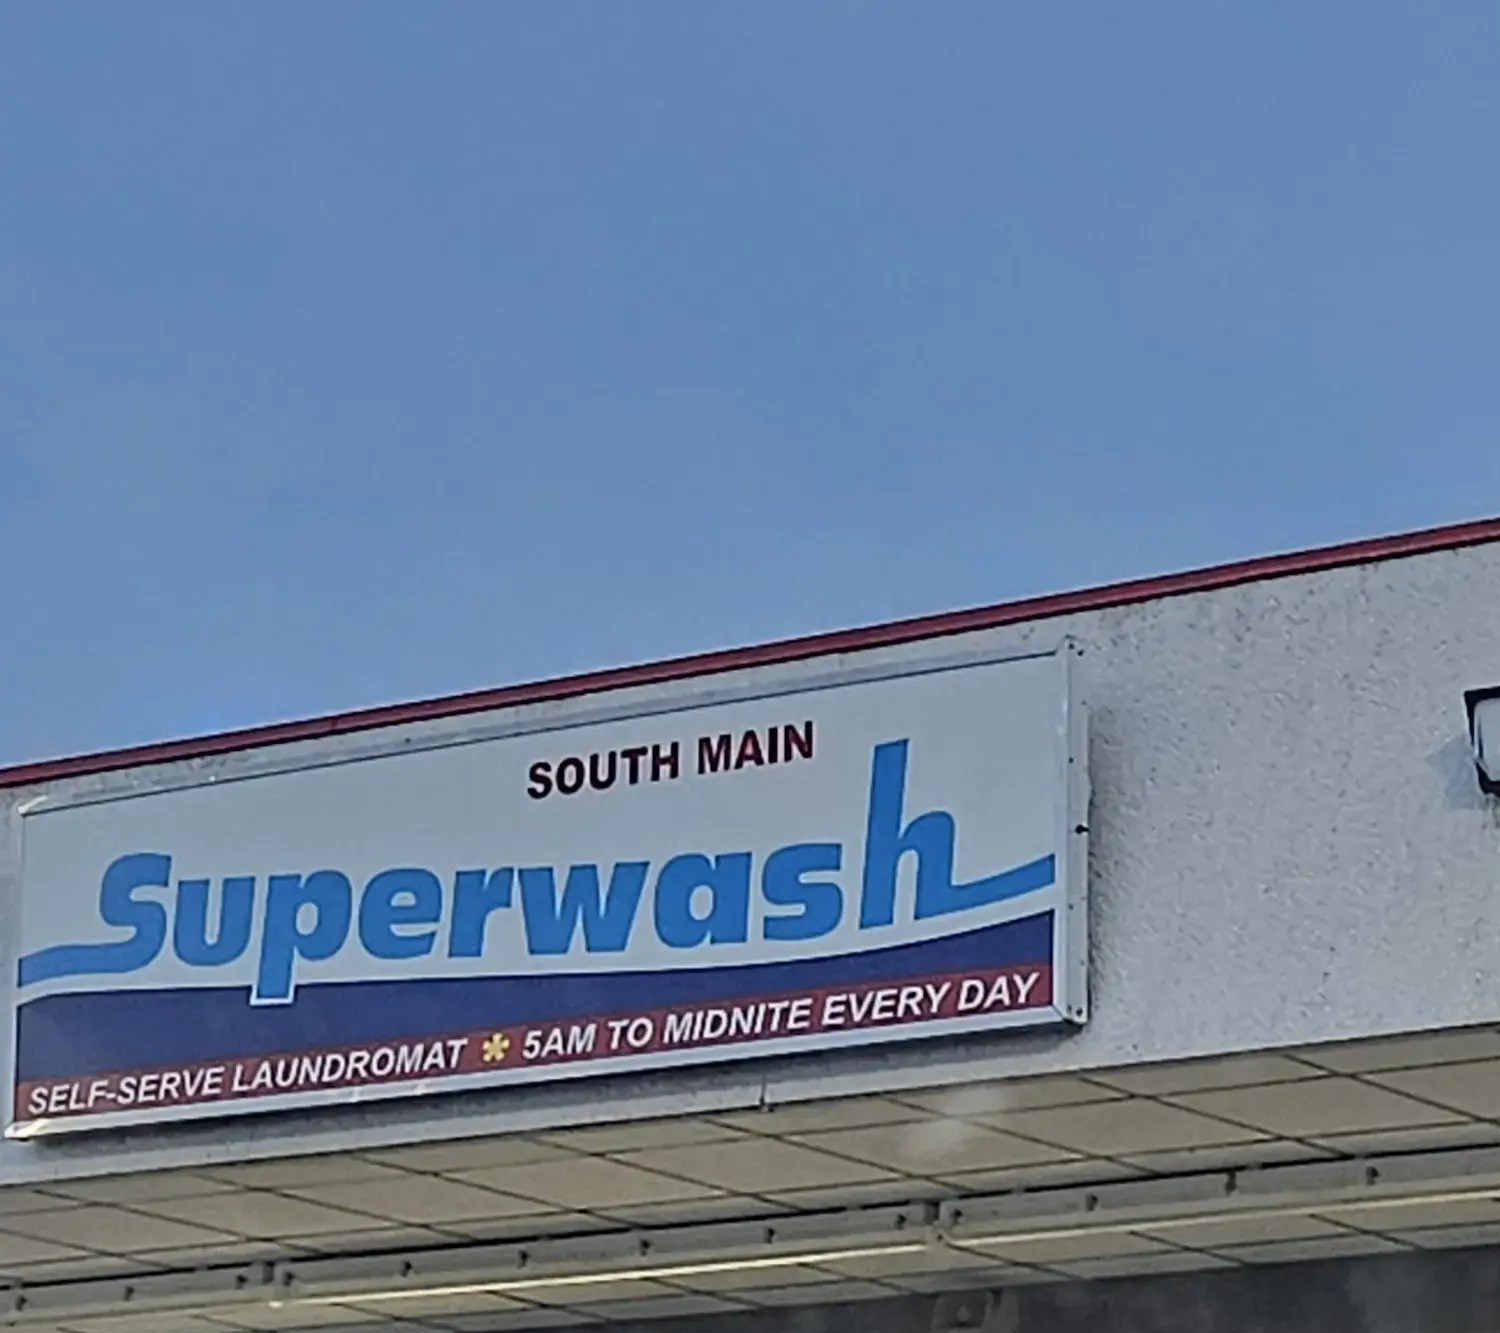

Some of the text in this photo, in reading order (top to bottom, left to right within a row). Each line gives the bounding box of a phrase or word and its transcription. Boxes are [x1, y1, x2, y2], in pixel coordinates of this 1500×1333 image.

[526, 719, 816, 801] SOUTH MAIN
[18, 738, 1055, 1002] Superwash
[27, 970, 1041, 1117] SELF-SERVE LAUNDROMAT 5AM TO MIDNITE EVERY DAY
